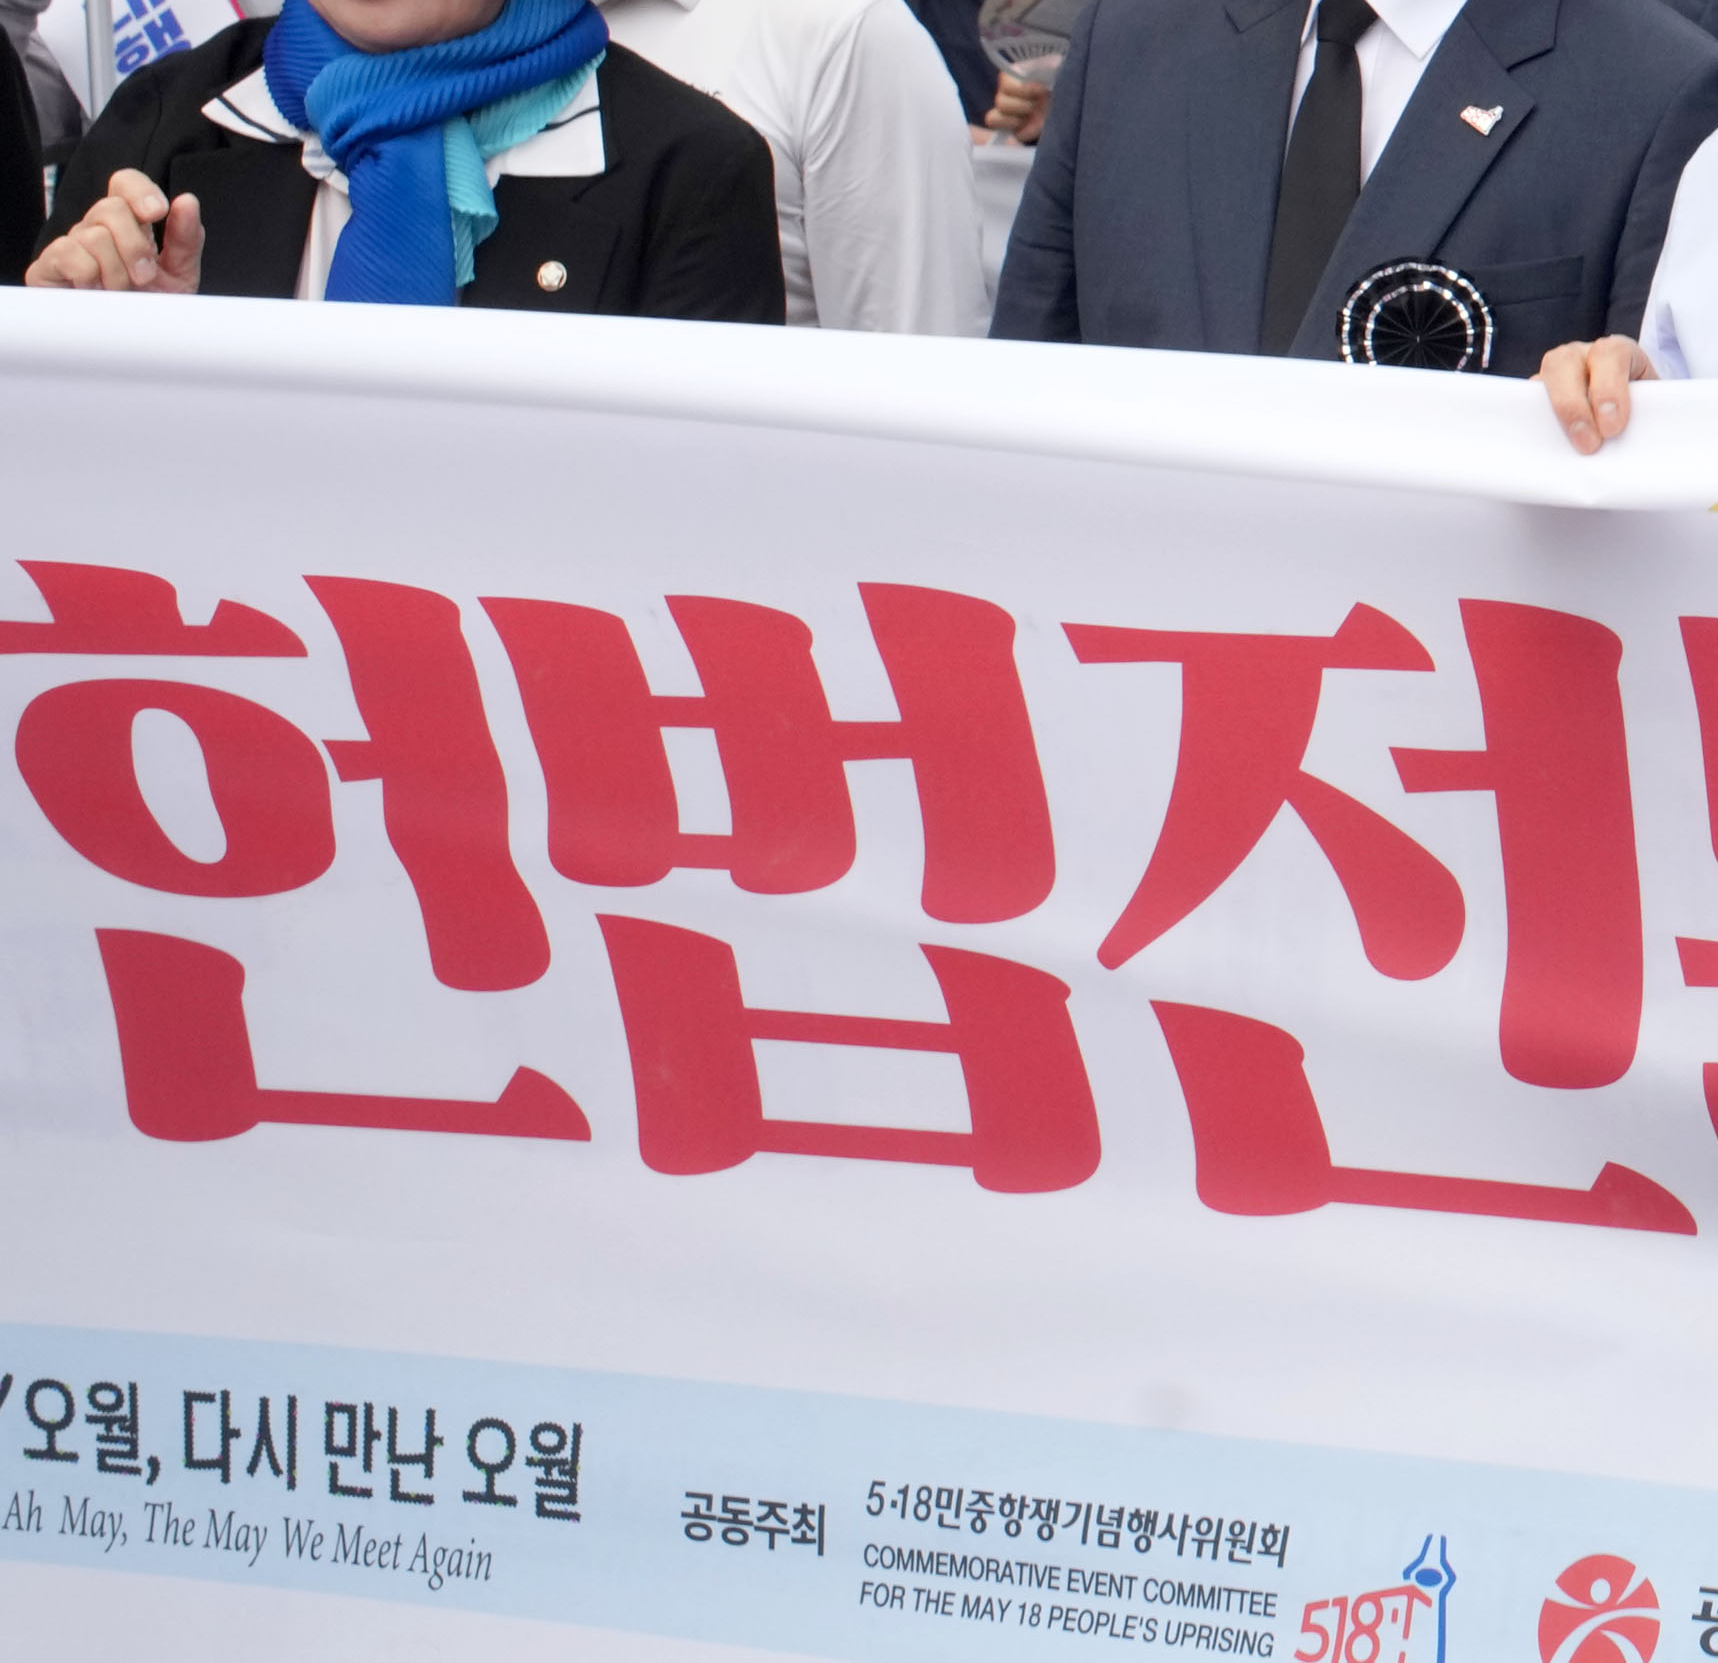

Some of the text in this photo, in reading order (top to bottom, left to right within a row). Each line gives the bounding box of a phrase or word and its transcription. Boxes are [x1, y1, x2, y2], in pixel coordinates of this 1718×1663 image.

[182, 1388, 299, 1491] 다시
[323, 1400, 445, 1506] 만난
[461, 1416, 584, 1524] 오월
[1, 1489, 495, 1592] Ah May, The May We Meet Again
[679, 1490, 827, 1557] 공동주최
[858, 1581, 1275, 1659] FOR THE MAY 18 PEOPLE'S UPRISING
[862, 1543, 1279, 1619] COMMEMORATIVE EVENT COMMITTEE
